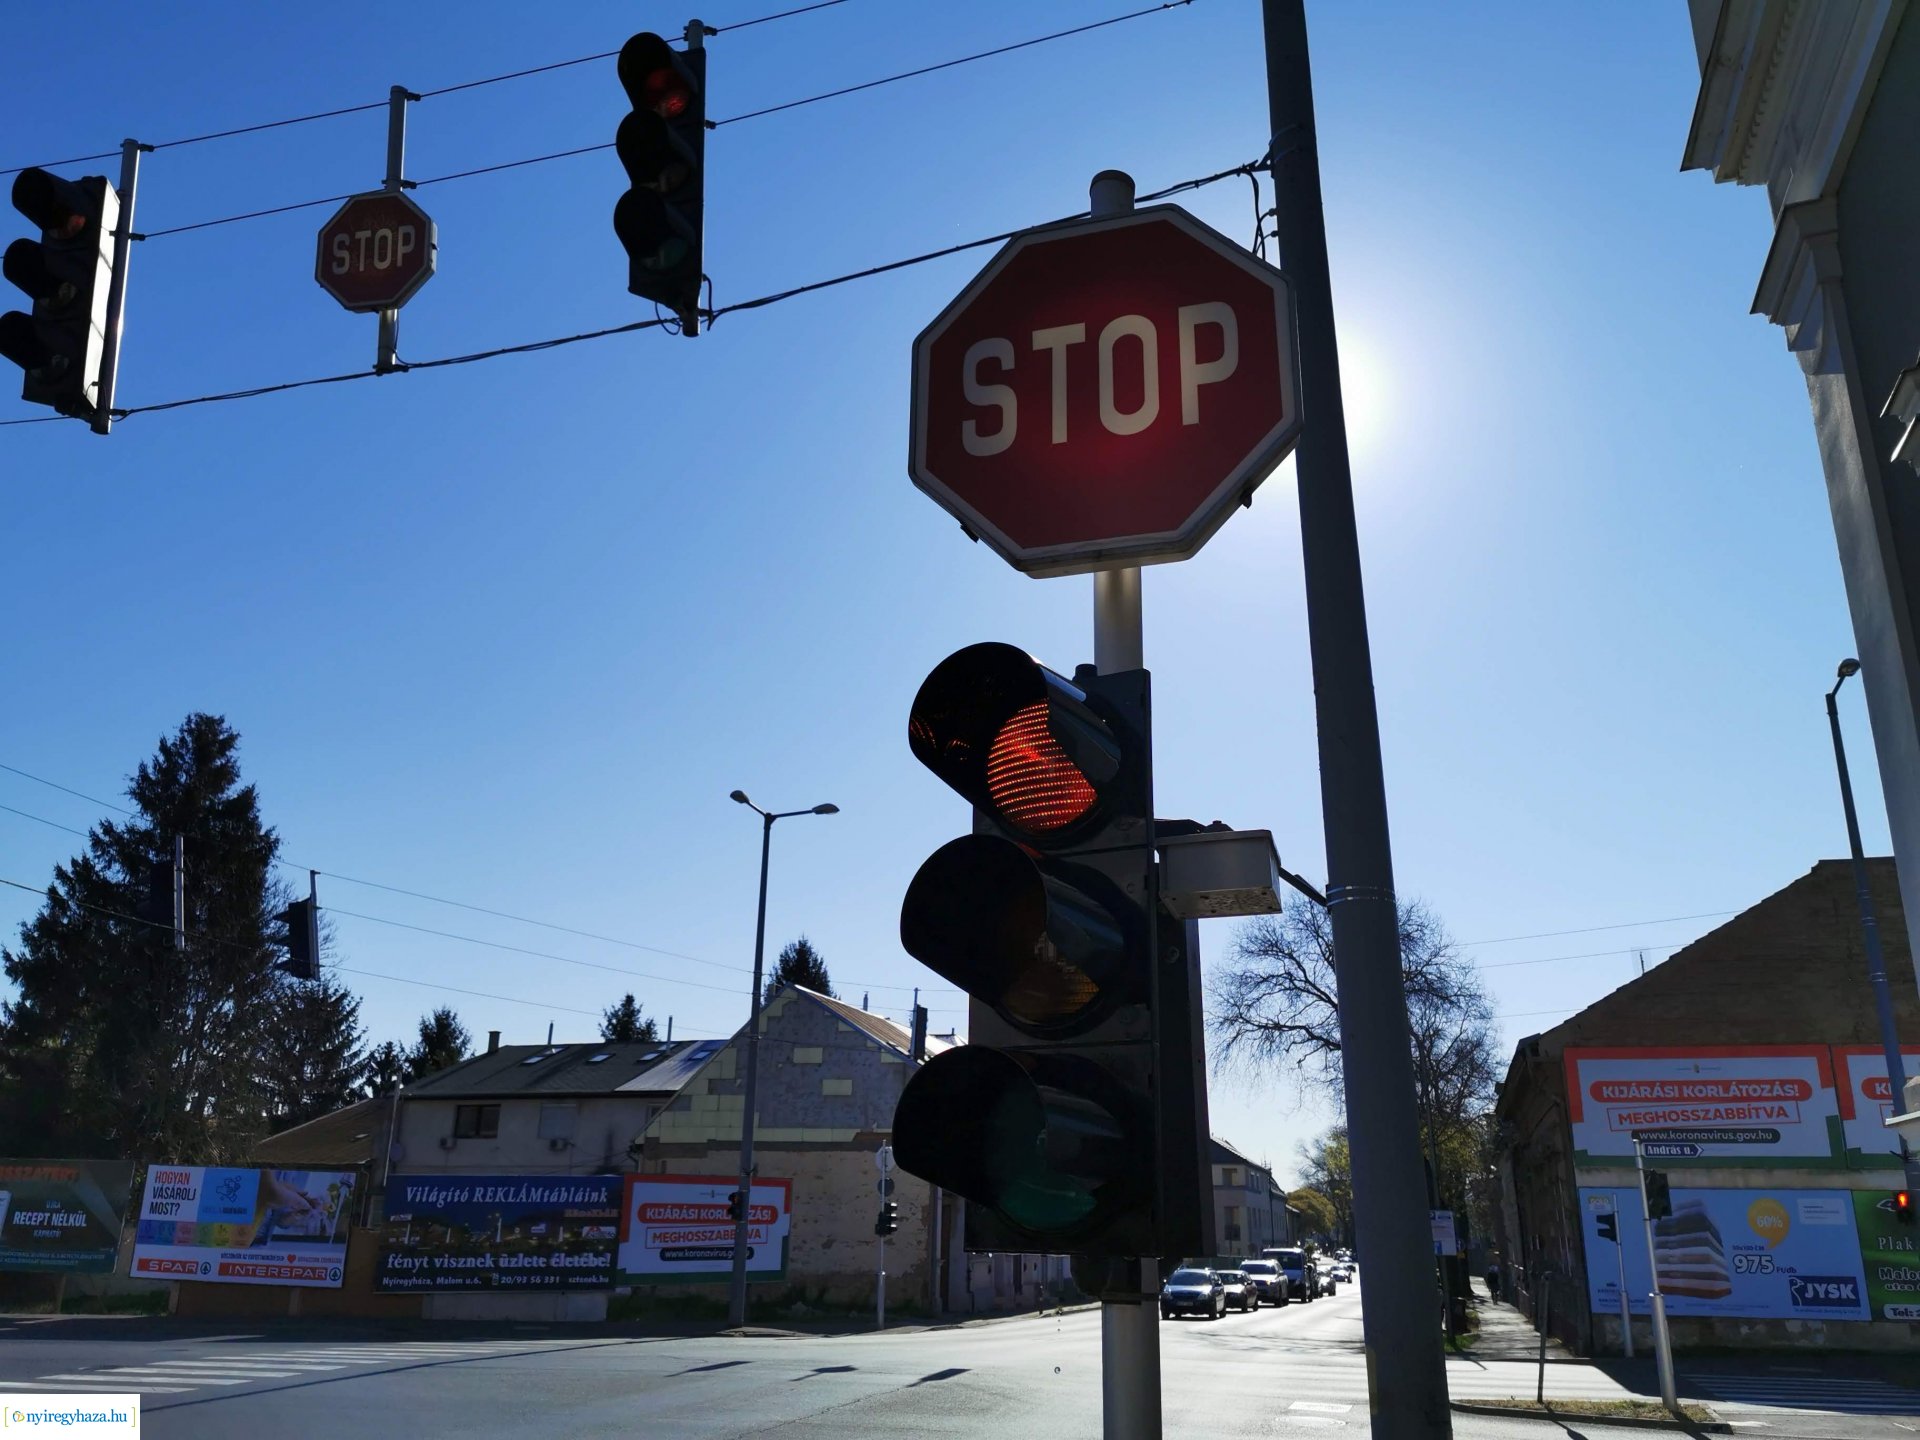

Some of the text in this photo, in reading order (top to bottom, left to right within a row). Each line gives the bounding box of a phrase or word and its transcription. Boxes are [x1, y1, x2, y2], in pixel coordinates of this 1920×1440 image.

[332, 225, 416, 275] STOP
[961, 301, 1239, 457] STOP
[1602, 1081, 1800, 1098] KIJÁRÁSI KORLÁTOZÁS!
[1618, 1104, 1789, 1125] MEGHOSSZABBÍTVA
[1639, 1130, 1773, 1142] www.koronavirus.gov.hu
[1647, 1144, 1695, 1155] András u.
[155, 1171, 190, 1185] HOGYAN
[152, 1185, 197, 1201] VÁSÁROLJ
[406, 1182, 608, 1208] Világító REKLÁMtábláink
[149, 1202, 180, 1216] MOST?
[646, 1205, 772, 1220] KIJÁRÁSI KORLZÁS!
[13, 1209, 87, 1227] RECEPT NÉLKÜL
[653, 1229, 761, 1243] MEGHOSSZABBVA
[1878, 1236, 1920, 1250] Plak
[149, 1260, 198, 1273] SPAR
[386, 1252, 612, 1273] fényt visznek üzlete életébe!
[1733, 1254, 1775, 1275] 975
[228, 1264, 328, 1279] INTERSPAR
[1878, 1267, 1920, 1281] Malo
[436, 1276, 463, 1285] Malom
[501, 1275, 528, 1285] 20/93
[530, 1275, 542, 1284] 56
[544, 1275, 560, 1284] 331
[1885, 1283, 1914, 1291] utca
[1805, 1283, 1856, 1299] JYSK
[1890, 1308, 1914, 1317] Tel:
